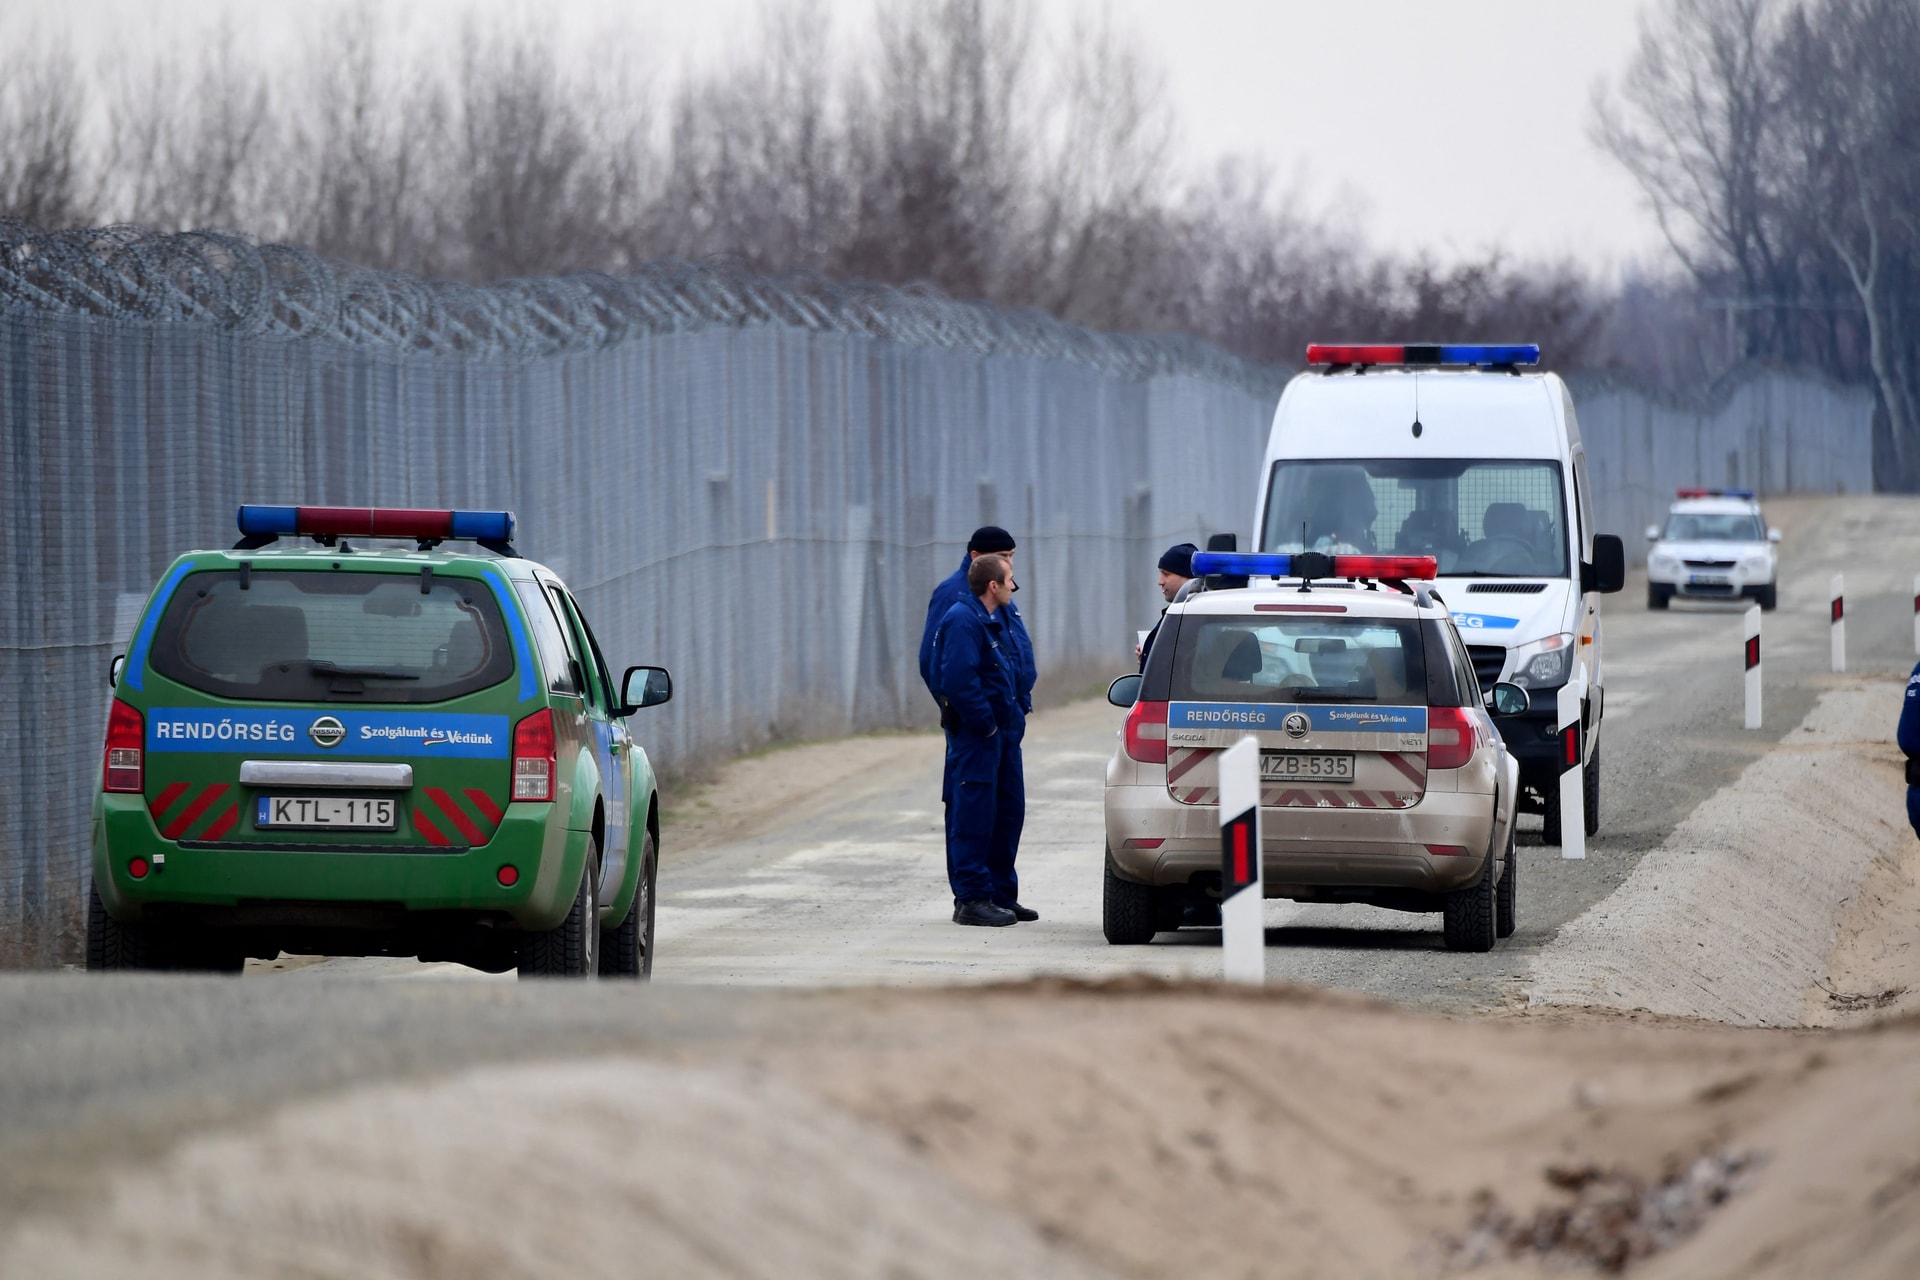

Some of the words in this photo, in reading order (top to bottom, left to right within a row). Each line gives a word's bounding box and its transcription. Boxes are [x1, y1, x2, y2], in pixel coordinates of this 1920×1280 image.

[1187, 709, 1266, 723] RENDŐRSÉG
[1329, 710, 1370, 721] Szolgálunk
[156, 718, 295, 741] RENDŐRSÉG
[360, 725, 428, 740] Szolgálunk
[430, 729, 444, 739] és
[446, 730, 493, 745] Védünk
[1259, 756, 1348, 775] MZB-535
[259, 812, 266, 820] H
[275, 799, 390, 824] KTL-115
